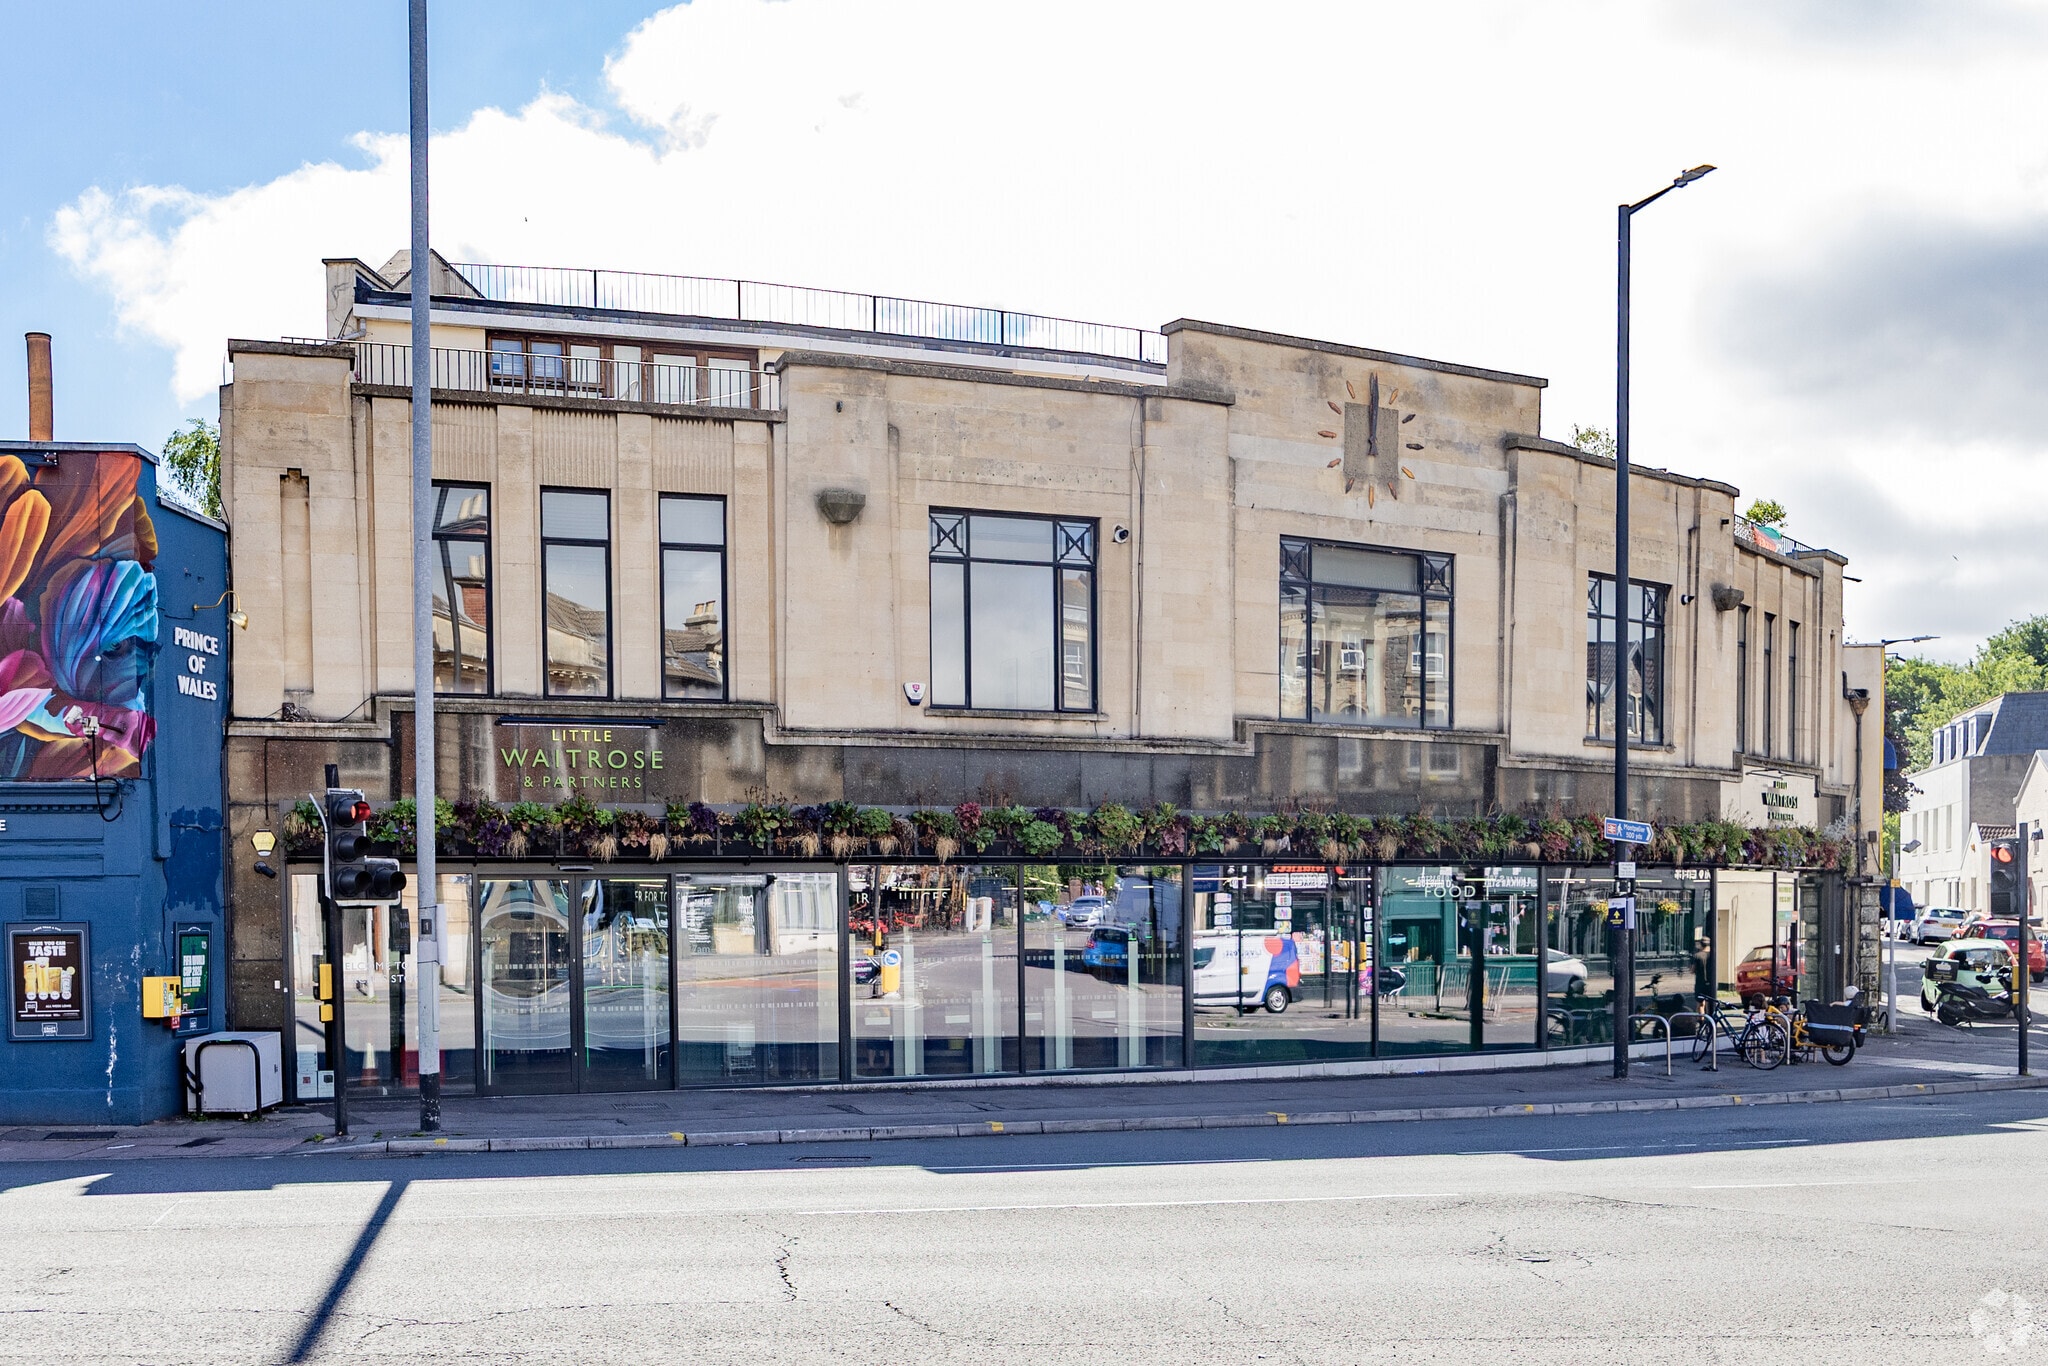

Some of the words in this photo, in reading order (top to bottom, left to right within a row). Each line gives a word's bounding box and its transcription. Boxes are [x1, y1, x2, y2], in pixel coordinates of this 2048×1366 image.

[174, 626, 219, 656] PRINCE
[188, 655, 207, 675] OF
[177, 675, 217, 701] WALES
[551, 729, 612, 743] LITTLE
[500, 748, 664, 770] WAITROSE
[523, 775, 534, 789] &
[542, 775, 643, 790] PARTNERS
[1626, 831, 1635, 839] 500
[644, 891, 658, 902] FOR
[1424, 885, 1476, 898] FOOD
[28, 945, 67, 957] TASTE
